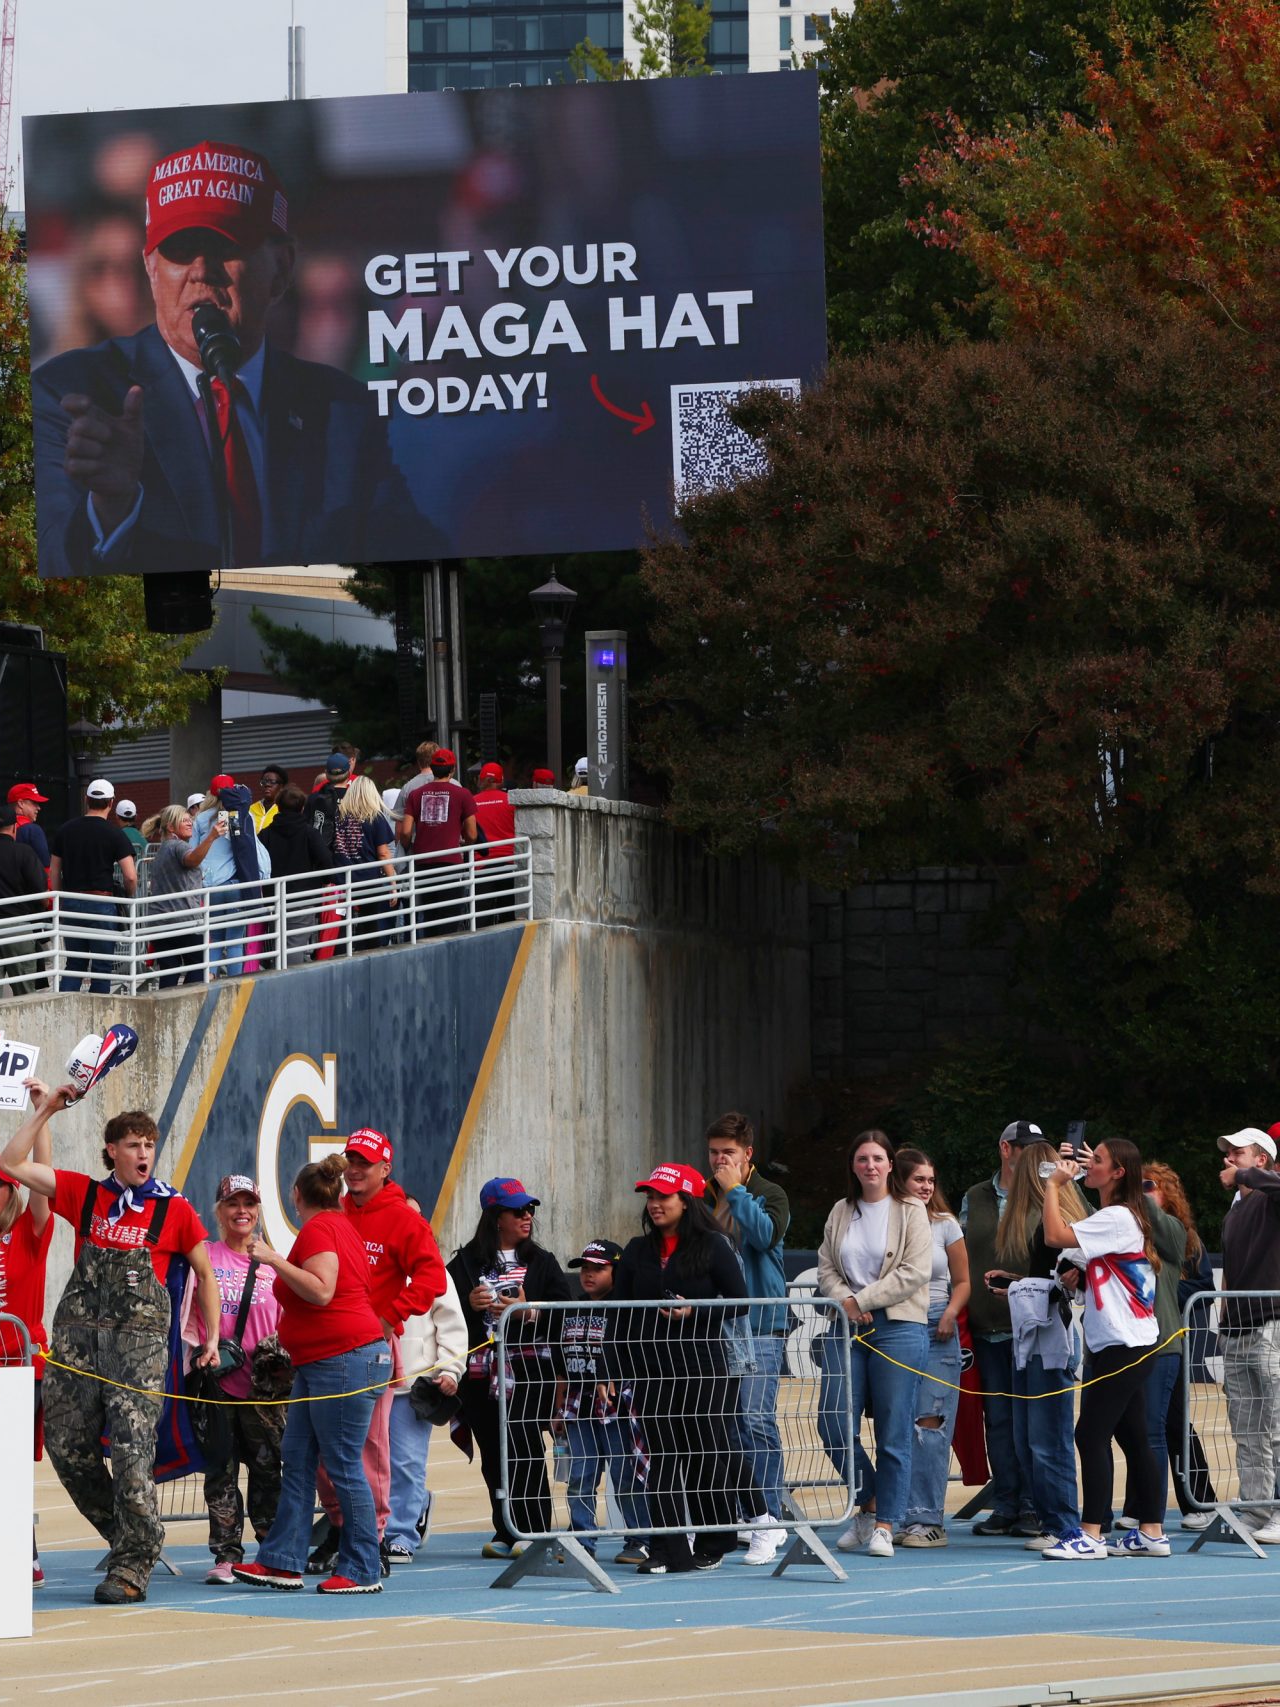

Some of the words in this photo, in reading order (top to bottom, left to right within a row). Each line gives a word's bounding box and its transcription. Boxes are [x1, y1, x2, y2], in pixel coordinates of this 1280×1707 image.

[153, 155, 191, 182] MAKE
[192, 152, 264, 182] AMERICA
[159, 179, 203, 207] GREAT
[205, 180, 254, 206] AGAIN
[364, 250, 470, 296] GET
[483, 242, 638, 289] YOUR
[367, 299, 587, 364] MAGA
[608, 290, 753, 352] HAT
[367, 372, 547, 417] TODAY!
[68, 1058, 82, 1077] EAM
[567, 1359, 597, 1374] 2024
